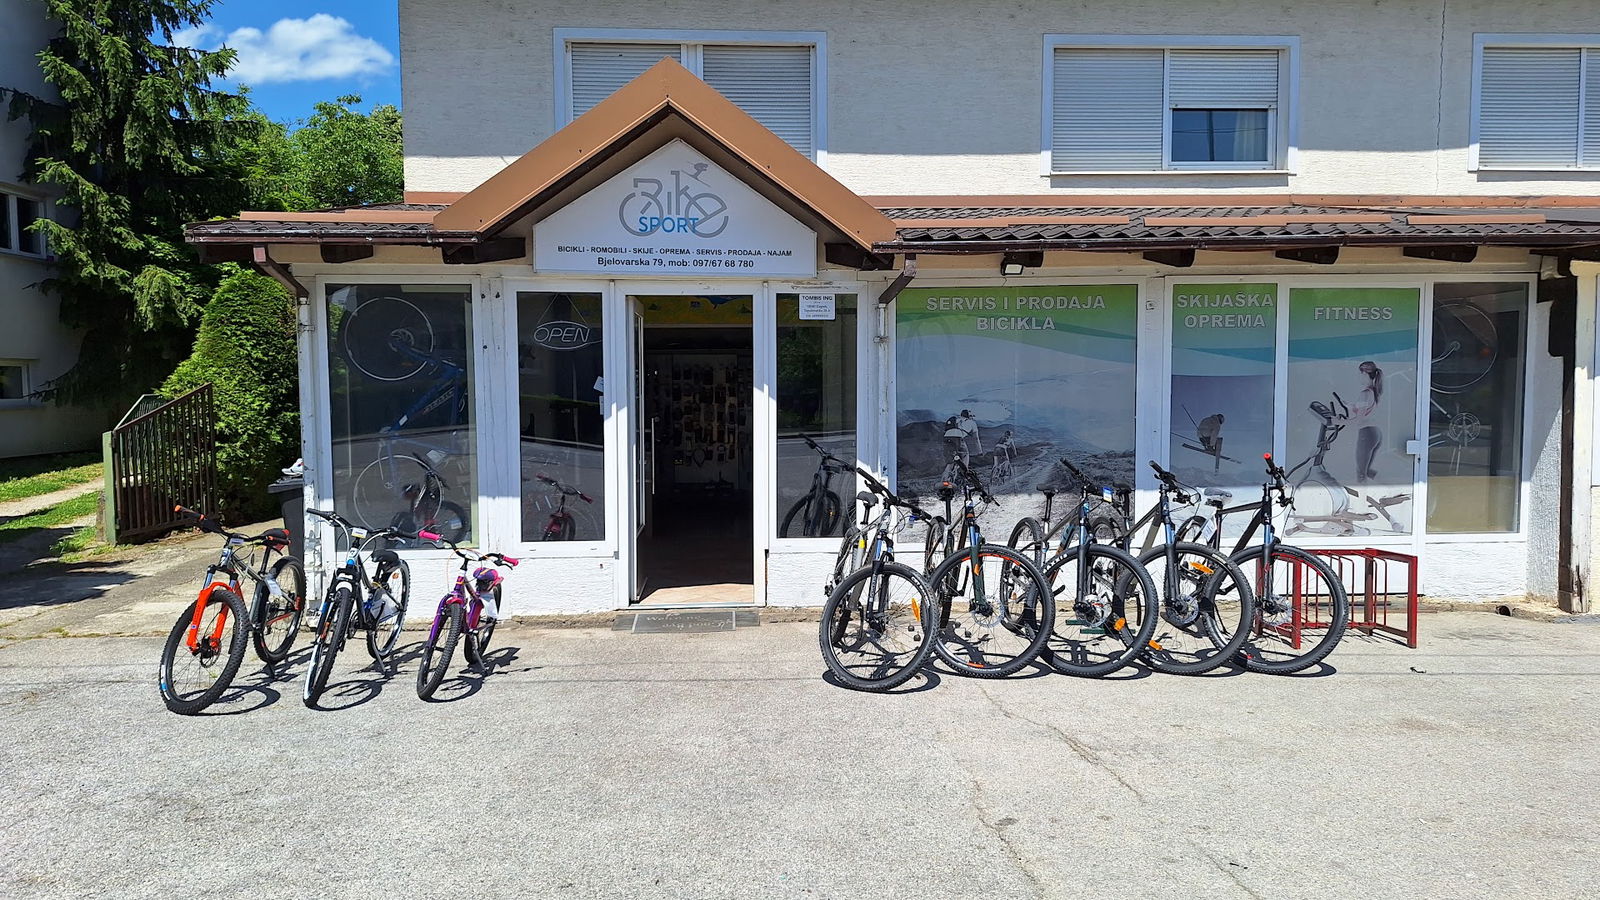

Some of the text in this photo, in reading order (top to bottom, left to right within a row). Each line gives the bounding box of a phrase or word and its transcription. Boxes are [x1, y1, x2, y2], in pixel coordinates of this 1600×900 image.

[638, 216, 699, 233] SPORT
[557, 245, 585, 253] BICIKLI
[590, 246, 627, 254] ROMOBILI
[597, 257, 754, 268] Bjelovarska 79, mob: 097/67 68 780
[926, 295, 1106, 311] SERVIS I PRODAJA
[1176, 291, 1274, 308] SKIJAŠKA
[1314, 307, 1393, 320] FITNESS
[976, 317, 1056, 331] BICIKLA
[1184, 314, 1266, 329] OPREMA
[533, 327, 591, 342] OPEN
